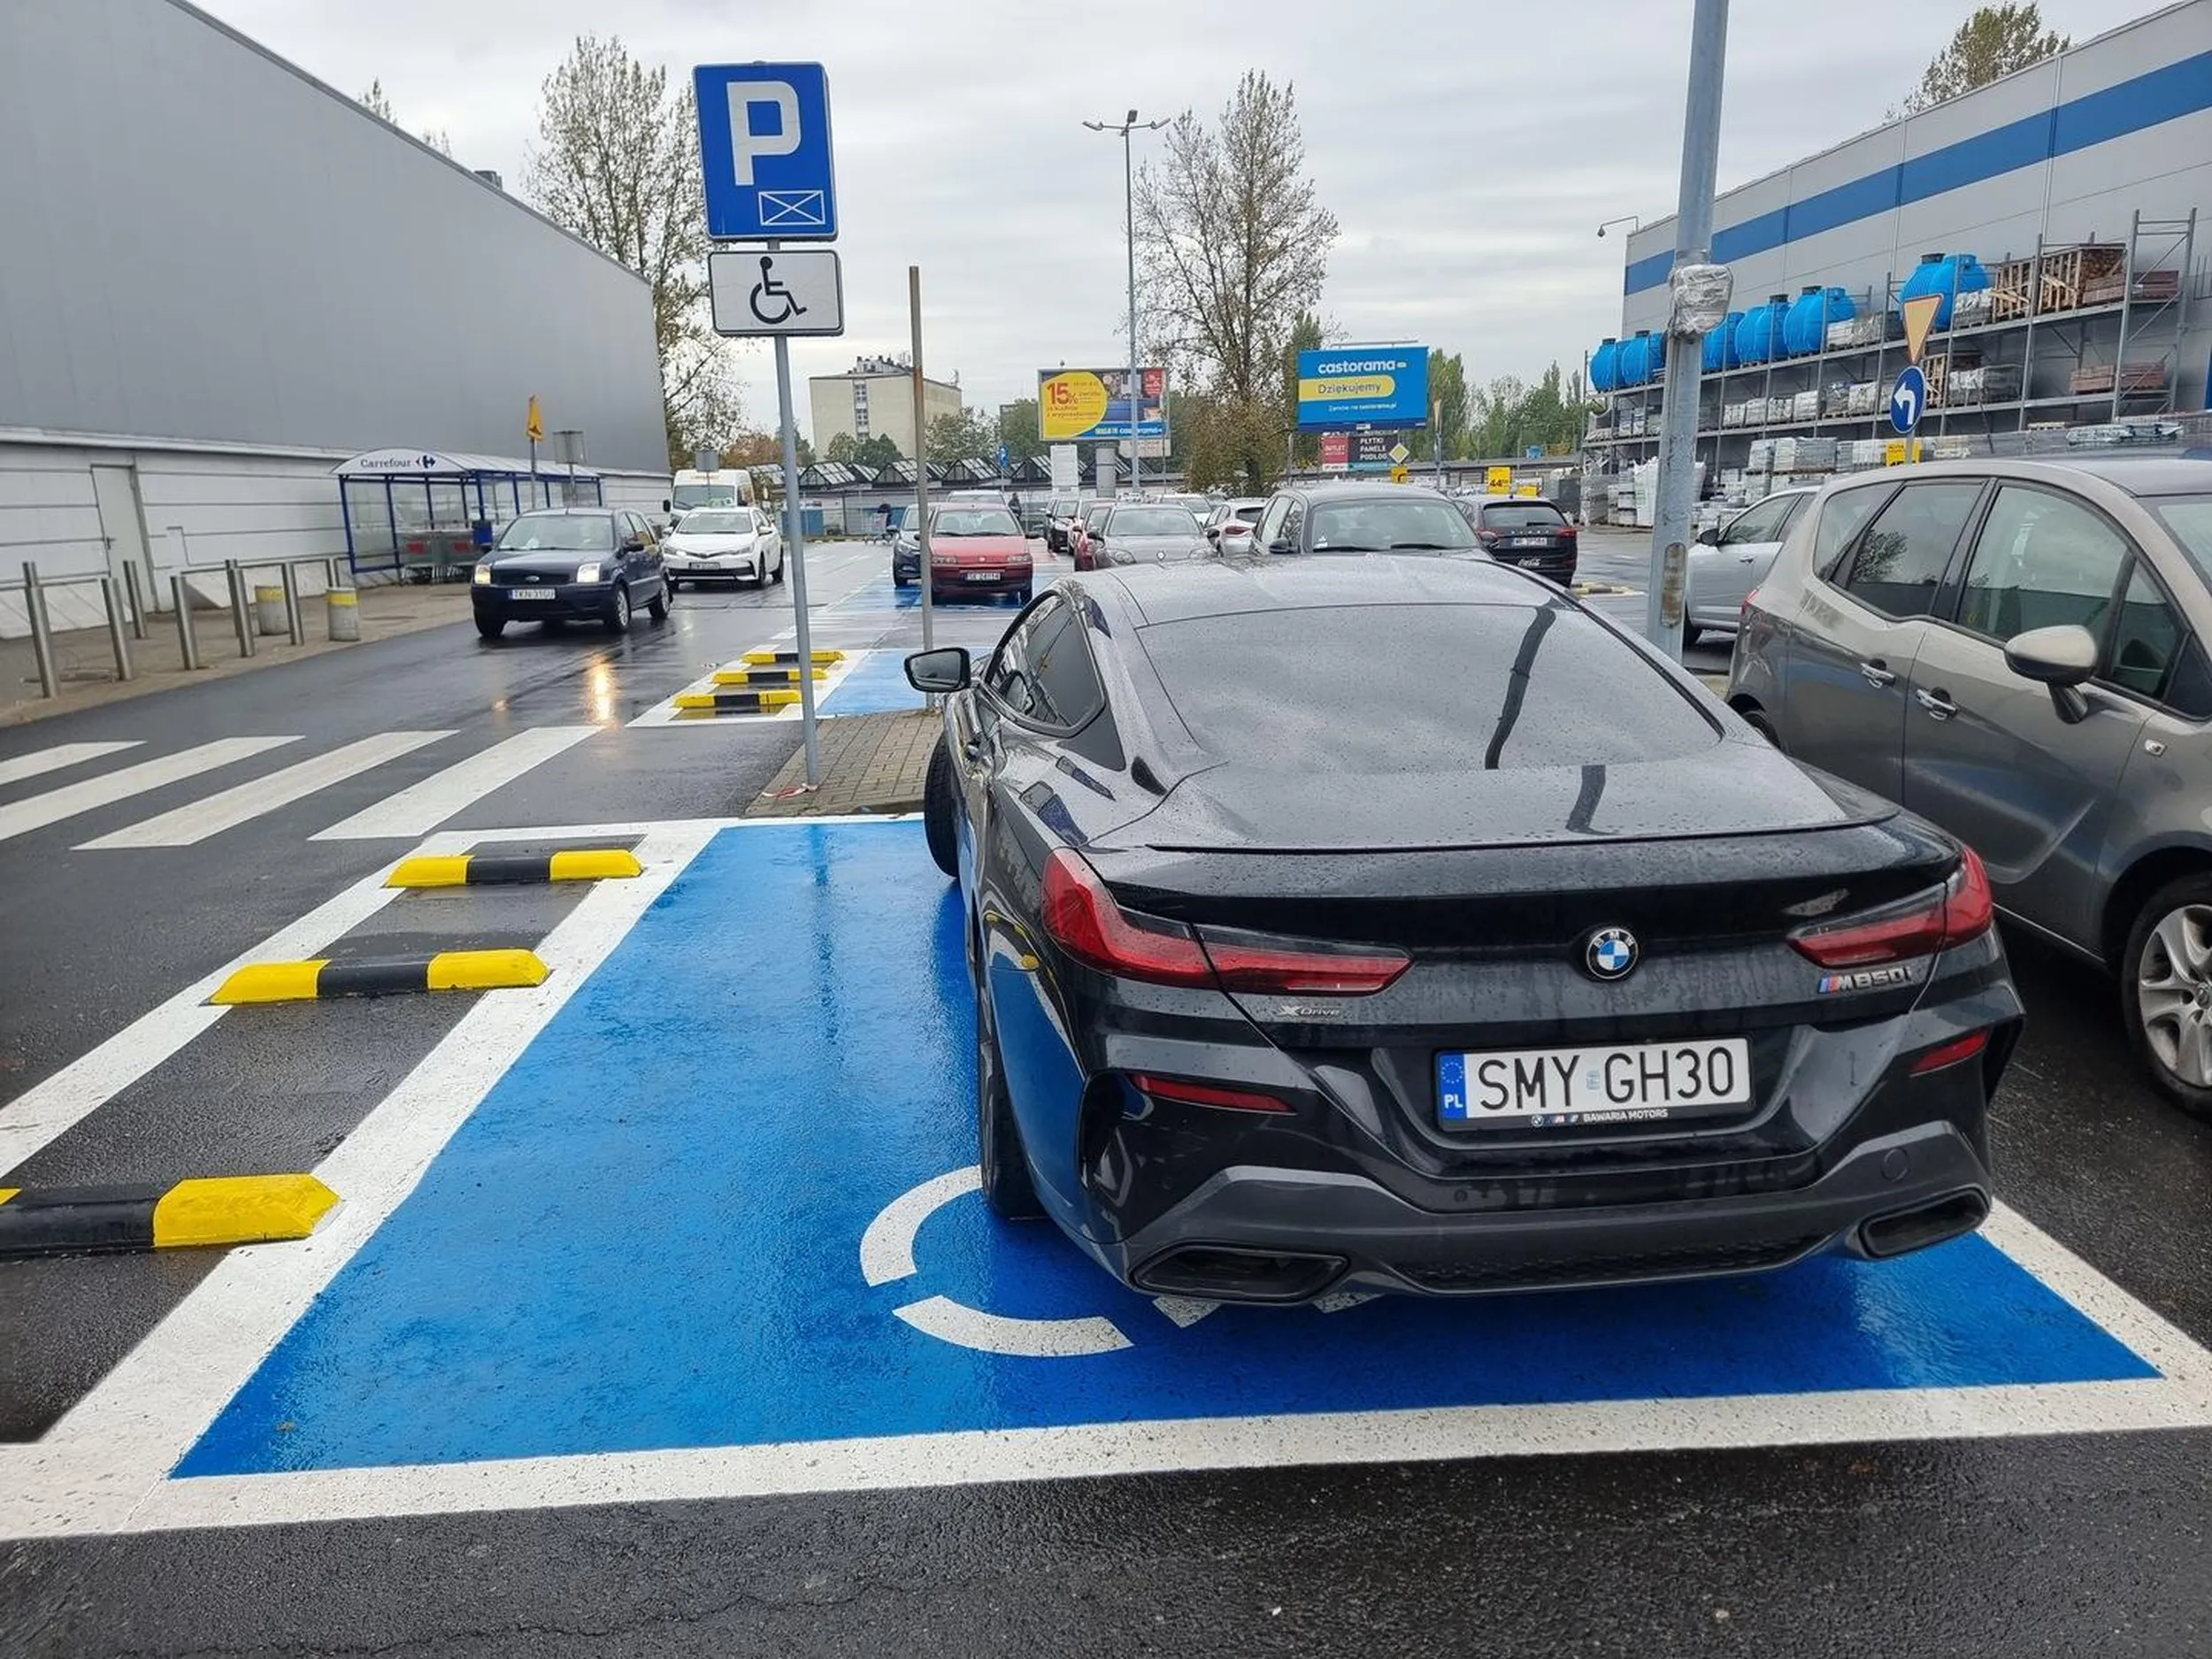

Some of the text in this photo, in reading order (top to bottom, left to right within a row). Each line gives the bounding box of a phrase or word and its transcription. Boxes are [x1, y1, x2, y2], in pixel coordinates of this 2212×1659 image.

[726, 81, 801, 186] P
[1317, 360, 1395, 374] castorama
[1047, 382, 1079, 405] 15%
[1317, 380, 1382, 395] Dziękujemy
[360, 458, 411, 468] Carrefour
[1478, 1046, 1734, 1110] SMY GH30
[1444, 1094, 1463, 1109] PL
[1583, 1111, 1627, 1123] BAWARIA
[1629, 1109, 1669, 1122] MOTORS
